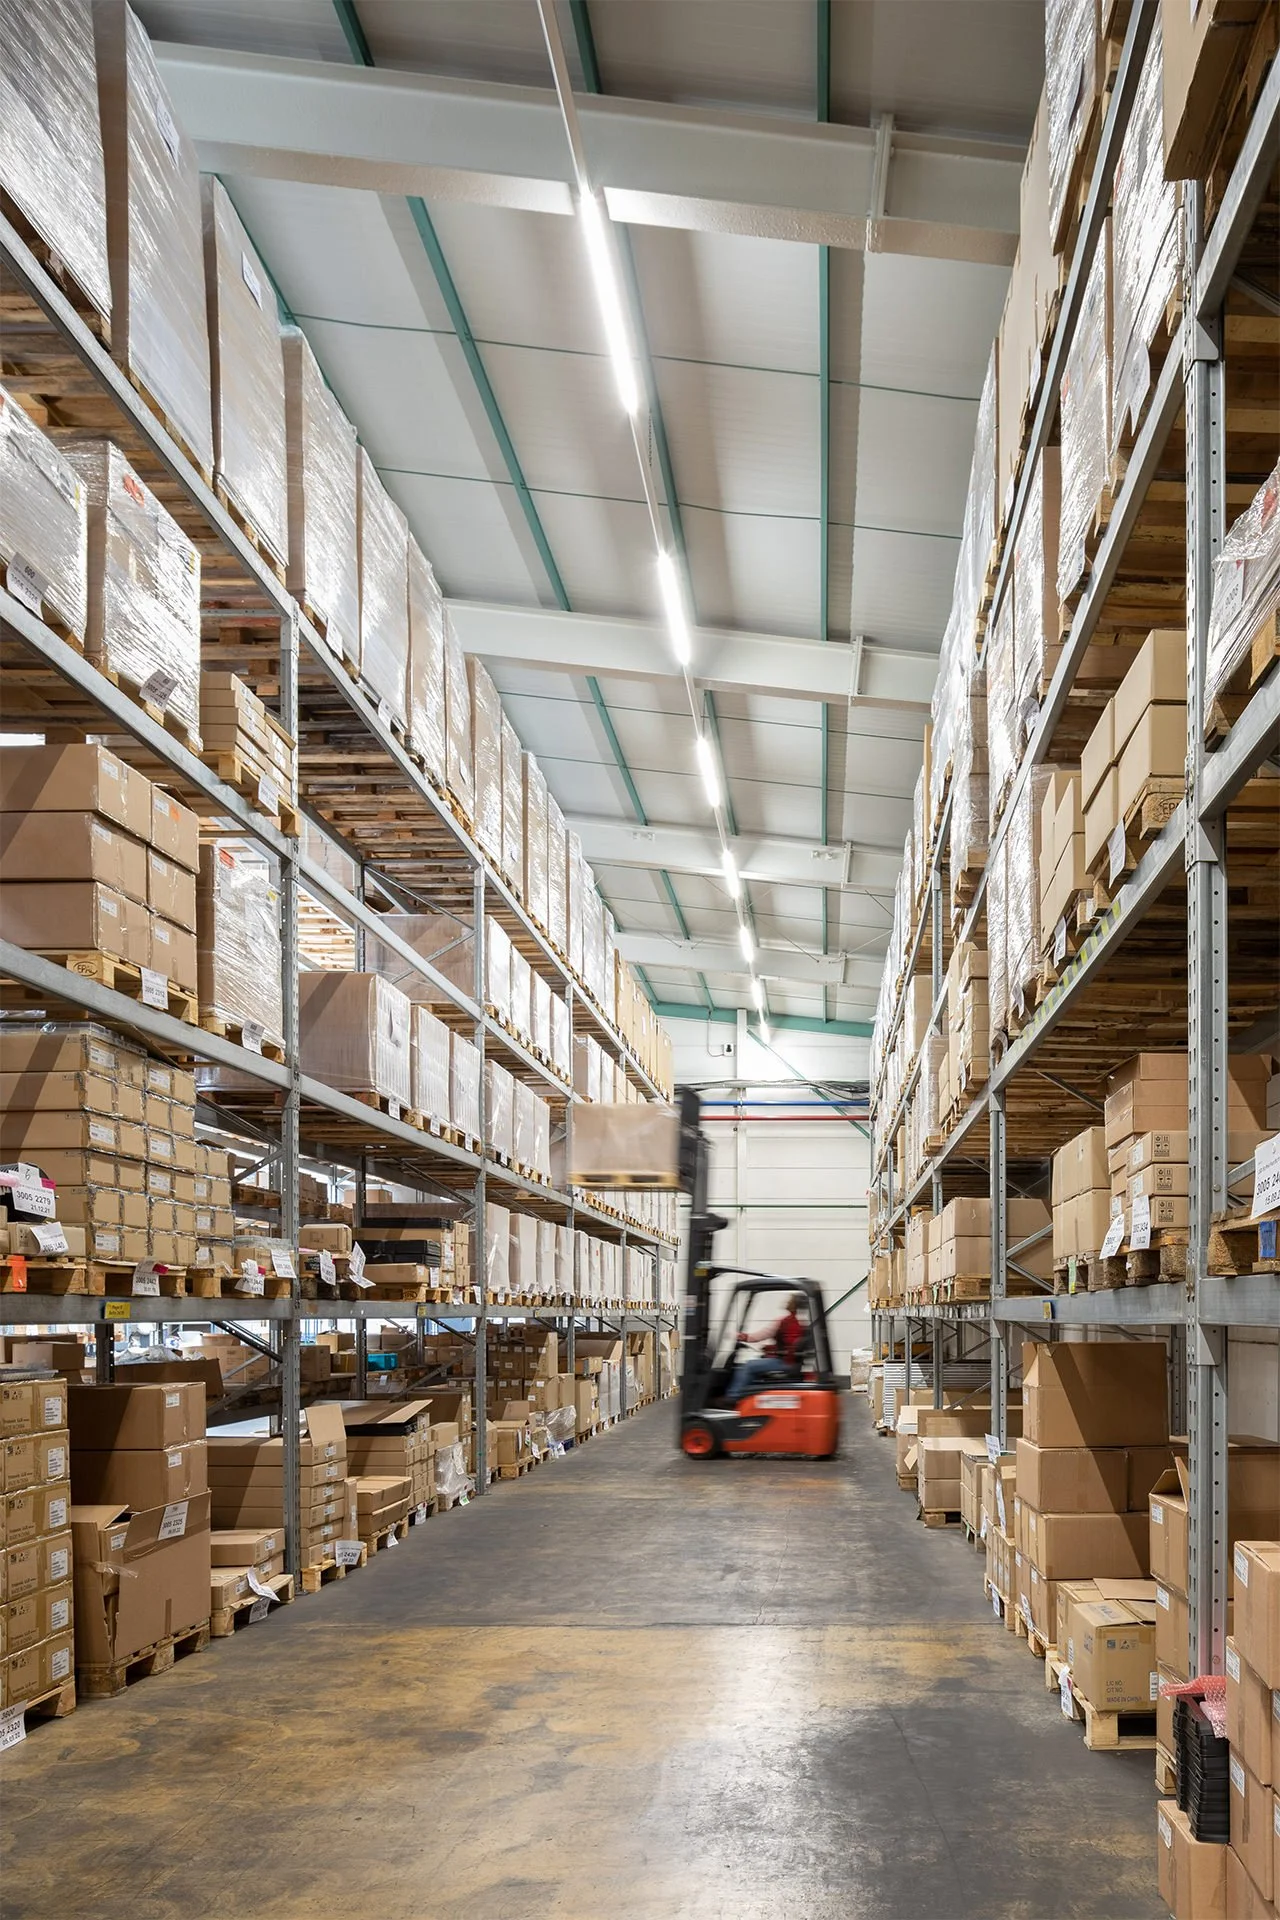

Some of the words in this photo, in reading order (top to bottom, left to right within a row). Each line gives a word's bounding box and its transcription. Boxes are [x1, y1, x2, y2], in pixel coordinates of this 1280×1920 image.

[16, 1191, 33, 1201] 3005
[35, 1195, 51, 1206] 2279
[30, 1204, 50, 1213] 21.12.21
